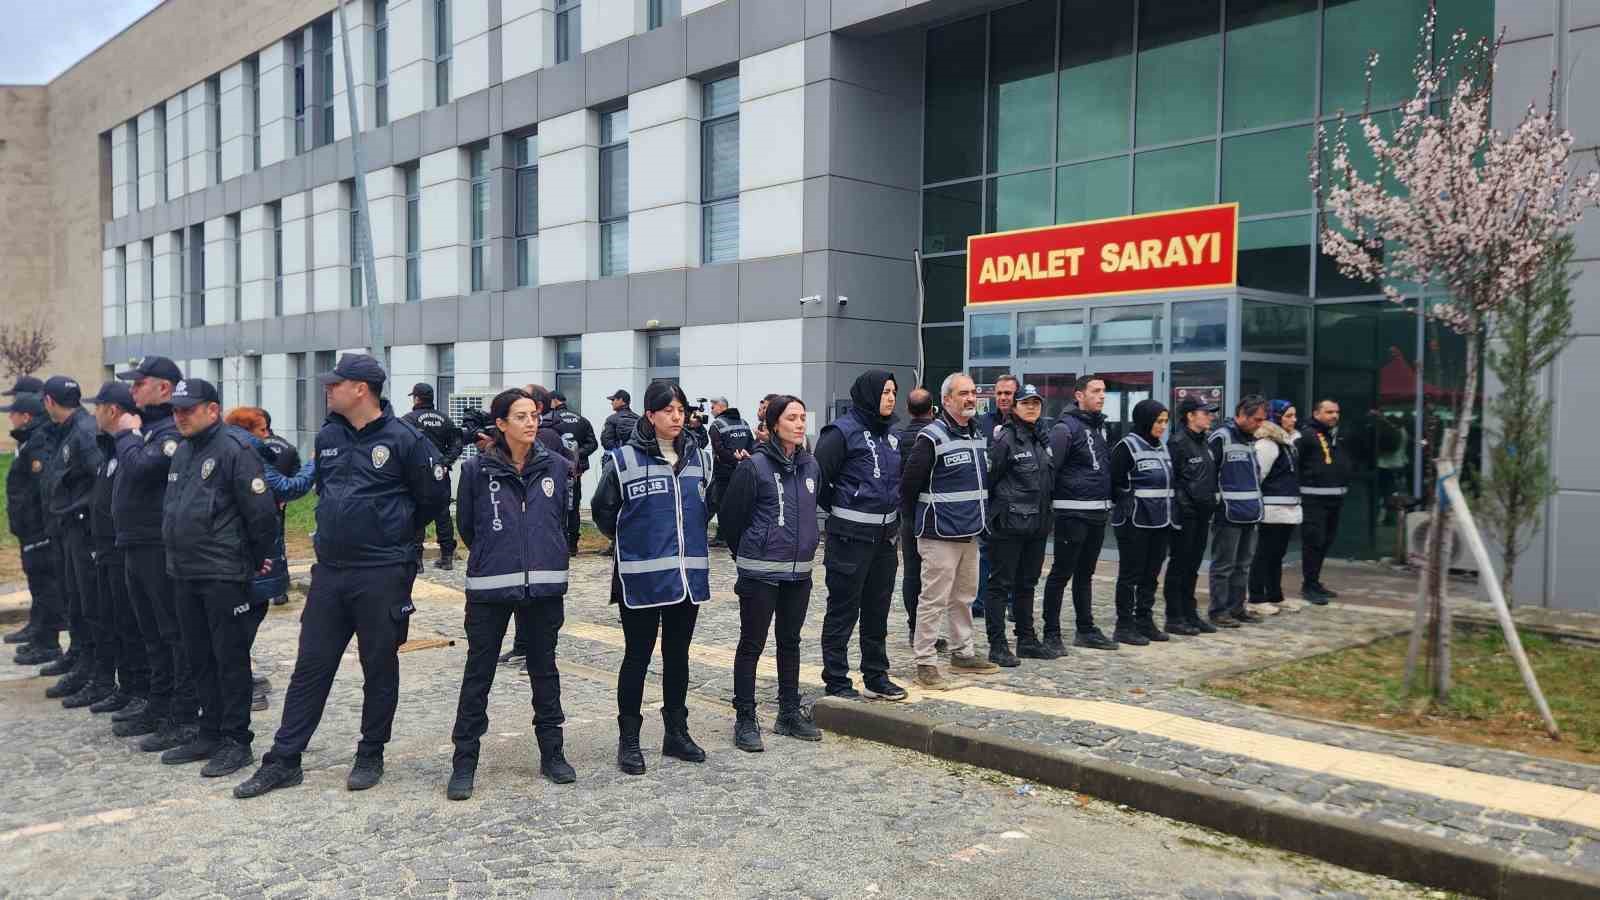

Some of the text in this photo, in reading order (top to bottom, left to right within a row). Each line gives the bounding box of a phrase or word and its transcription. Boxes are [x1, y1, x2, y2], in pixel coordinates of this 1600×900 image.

[978, 232, 1222, 285] ADALET SARAYI
[863, 430, 881, 479] POLIS
[947, 454, 969, 464] POLIS
[632, 481, 663, 495] POLIS
